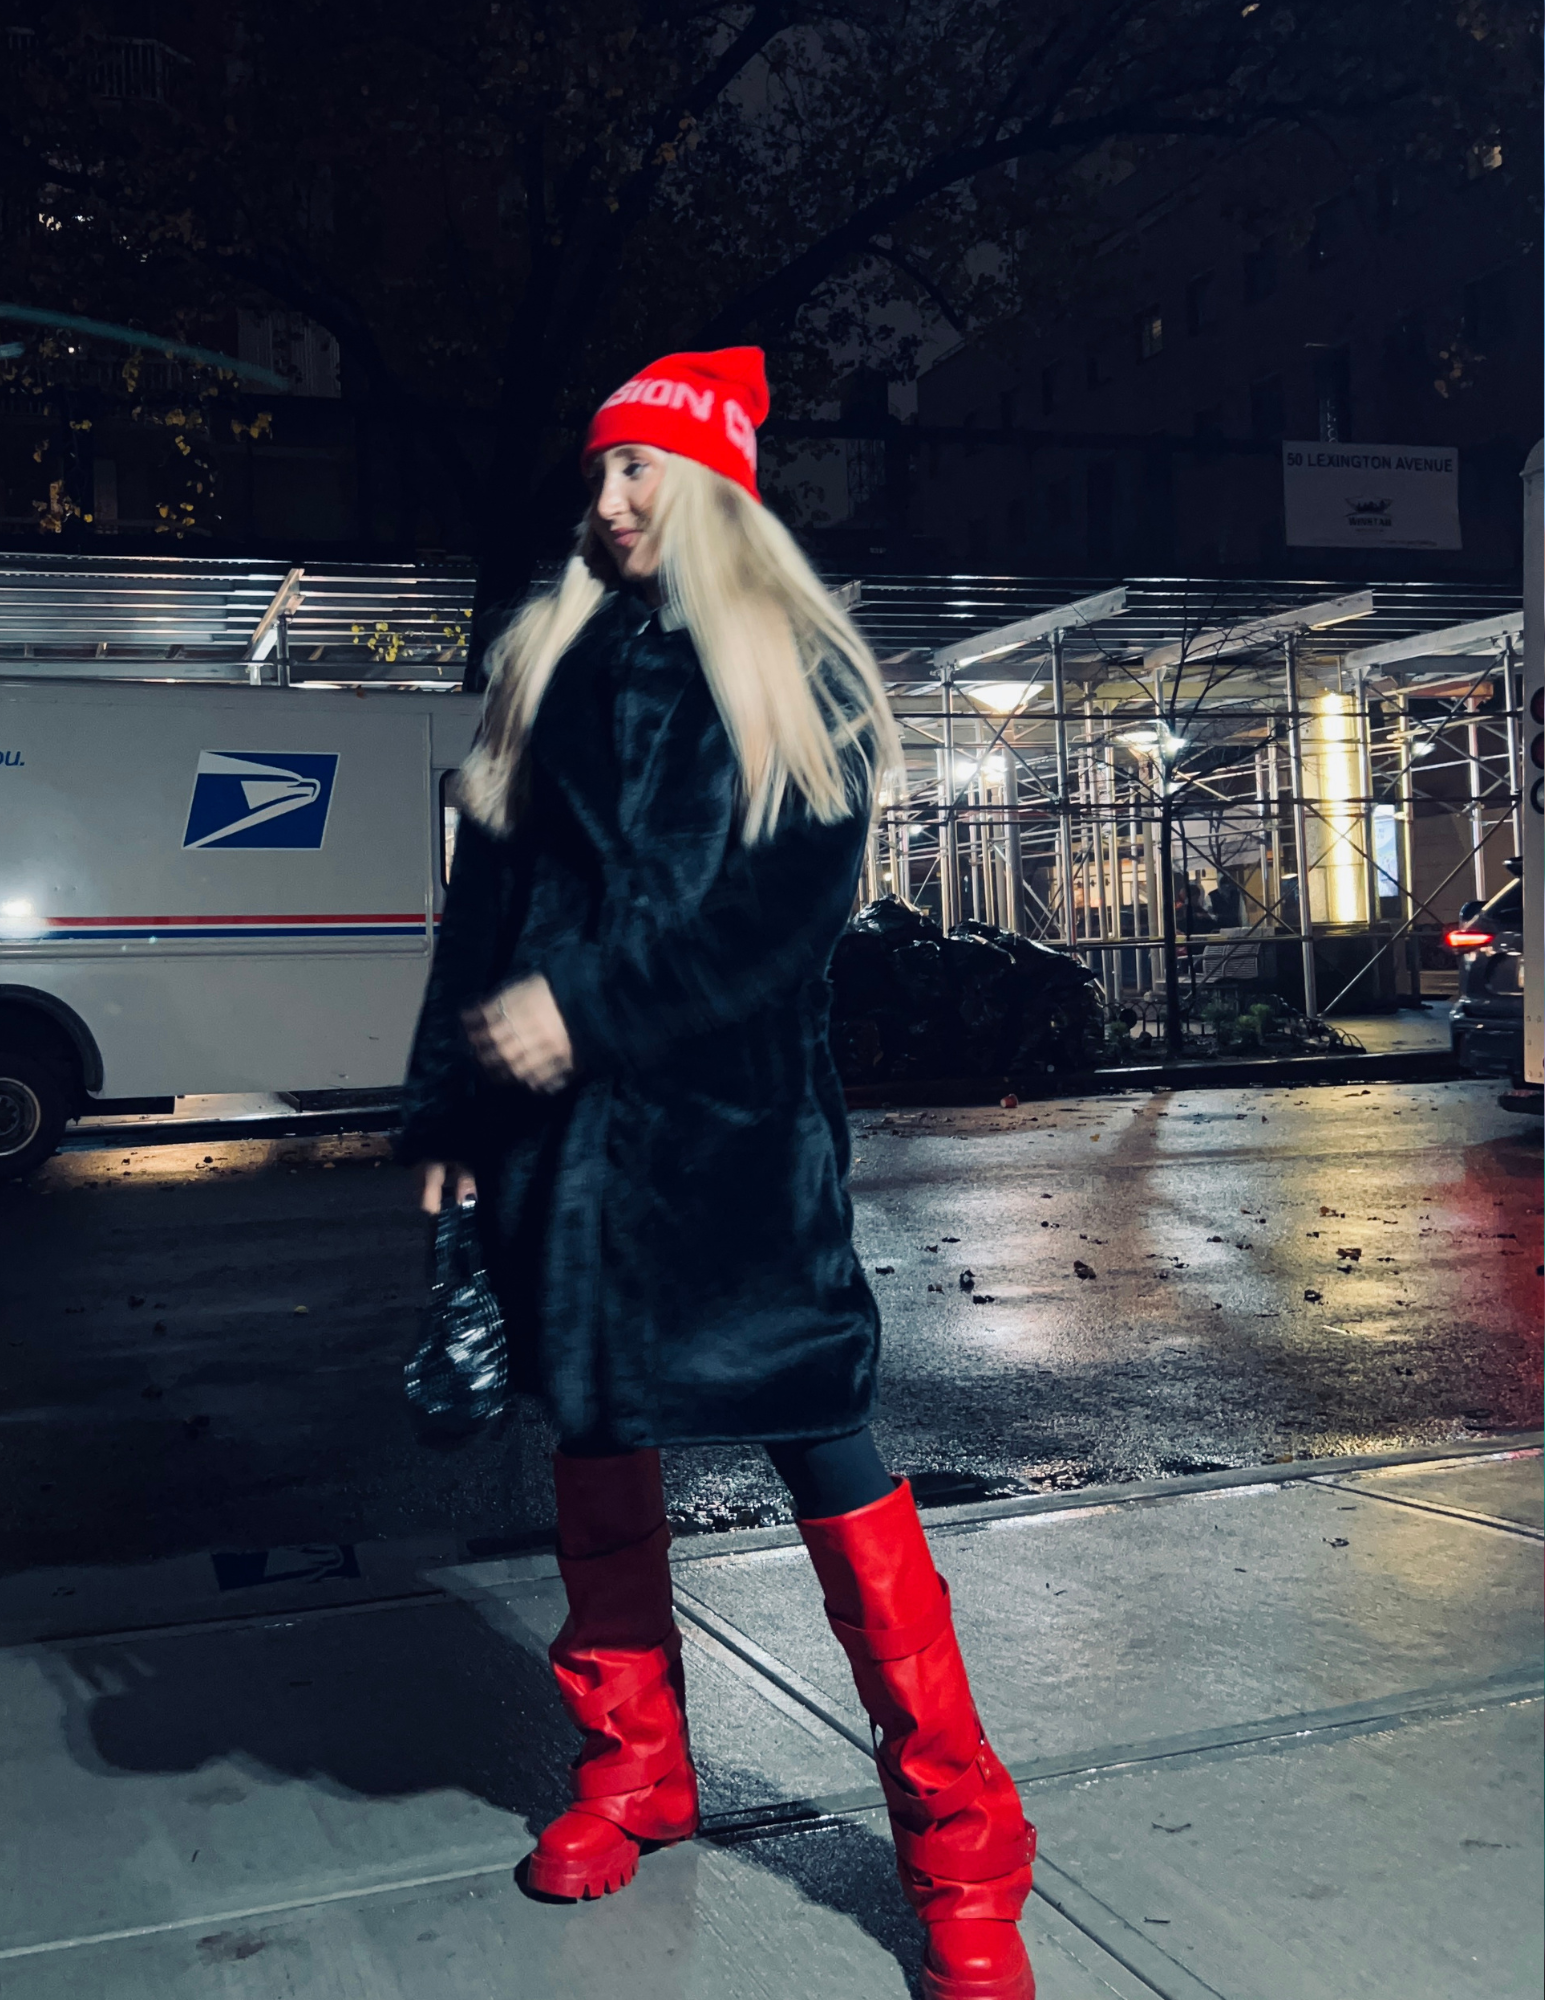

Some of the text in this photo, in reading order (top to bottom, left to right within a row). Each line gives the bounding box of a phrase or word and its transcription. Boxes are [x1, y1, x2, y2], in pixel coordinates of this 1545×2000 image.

[1287, 452, 1453, 473] 50 LEXINGTON AVENUE
